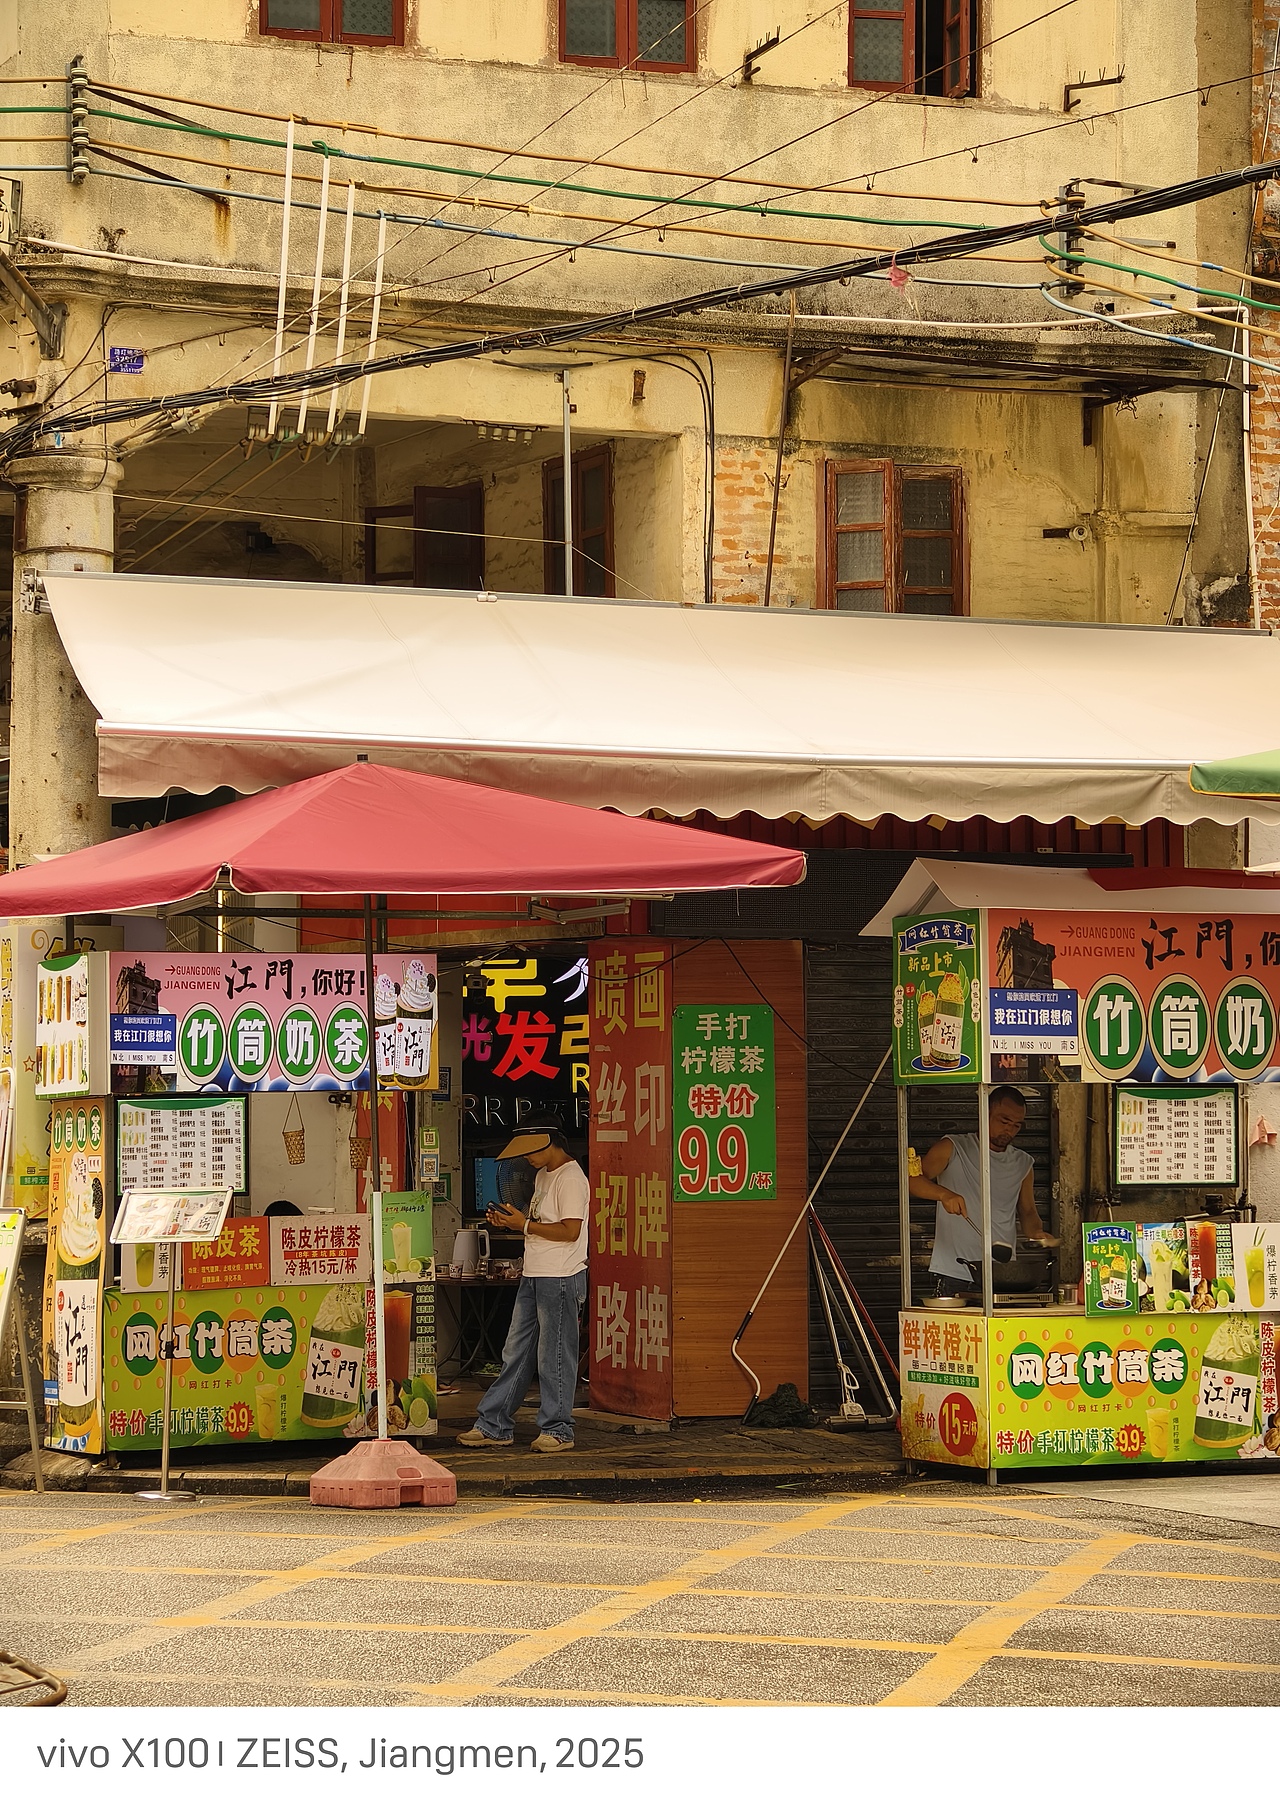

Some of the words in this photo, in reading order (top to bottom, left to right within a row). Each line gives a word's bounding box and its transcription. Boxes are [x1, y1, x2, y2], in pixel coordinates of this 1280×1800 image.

[1076, 926, 1107, 940] GUANG
[1109, 927, 1136, 940] DONG
[908, 951, 953, 978] 新品上市
[1060, 946, 1136, 958] JIANGMEN
[164, 980, 220, 990] JIANGMEN
[176, 965, 201, 976] GUANG
[201, 966, 221, 976] DONG
[595, 950, 665, 1035] 喷画
[695, 1012, 752, 1041] 手打
[994, 1008, 1073, 1026] 我在江门很想你
[1093, 994, 1266, 1057] 竹筒奶
[113, 1029, 172, 1043] 我在江门很想你
[186, 1017, 364, 1068] 竹筒奶茶
[1019, 1041, 1035, 1050] MISS
[1039, 1041, 1052, 1050] YOU
[681, 1045, 765, 1075] 柠檬茶
[595, 1061, 666, 1146] 丝印
[689, 1083, 758, 1119] 特价
[678, 1125, 750, 1195] 9.9
[595, 1170, 669, 1259] 招牌
[281, 1224, 362, 1250] 陈皮柠檬茶
[284, 1258, 358, 1277] 冷热15元/杯
[124, 1318, 294, 1362] 网红竹筒茶
[595, 1282, 670, 1373] 路牌
[902, 1319, 983, 1365] 鲜榨橙汁
[311, 1353, 359, 1389] 江門
[1011, 1348, 1186, 1388] 网红竹筒茶
[1261, 1321, 1277, 1413] 陈皮柠檬茶
[188, 1379, 233, 1391] 网红打卡
[1203, 1380, 1252, 1413] 江門
[914, 1410, 936, 1430] 特价
[942, 1402, 962, 1445] 15
[1077, 1403, 1123, 1413] 网红打卡
